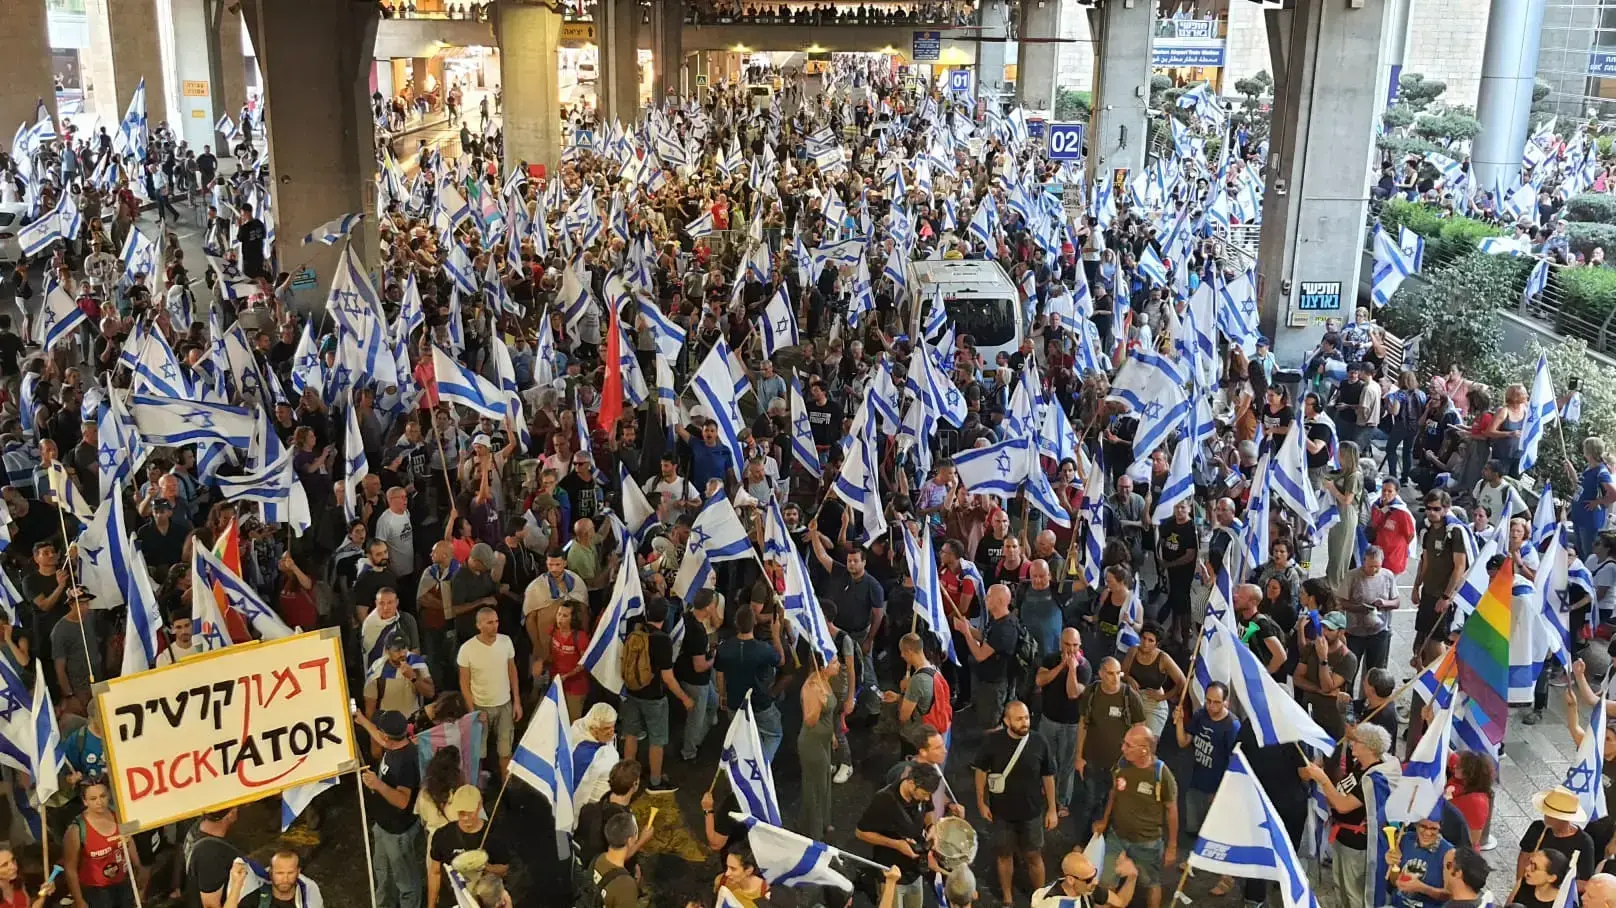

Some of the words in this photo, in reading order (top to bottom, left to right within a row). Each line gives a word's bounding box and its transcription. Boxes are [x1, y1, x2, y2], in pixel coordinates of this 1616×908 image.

[1179, 22, 1208, 30] חופשי
[953, 74, 968, 88] 01
[1051, 131, 1079, 153] 02
[1302, 283, 1340, 294] חופשי
[1301, 295, 1338, 308] בארצנו
[126, 716, 343, 801] DICKTATOR
